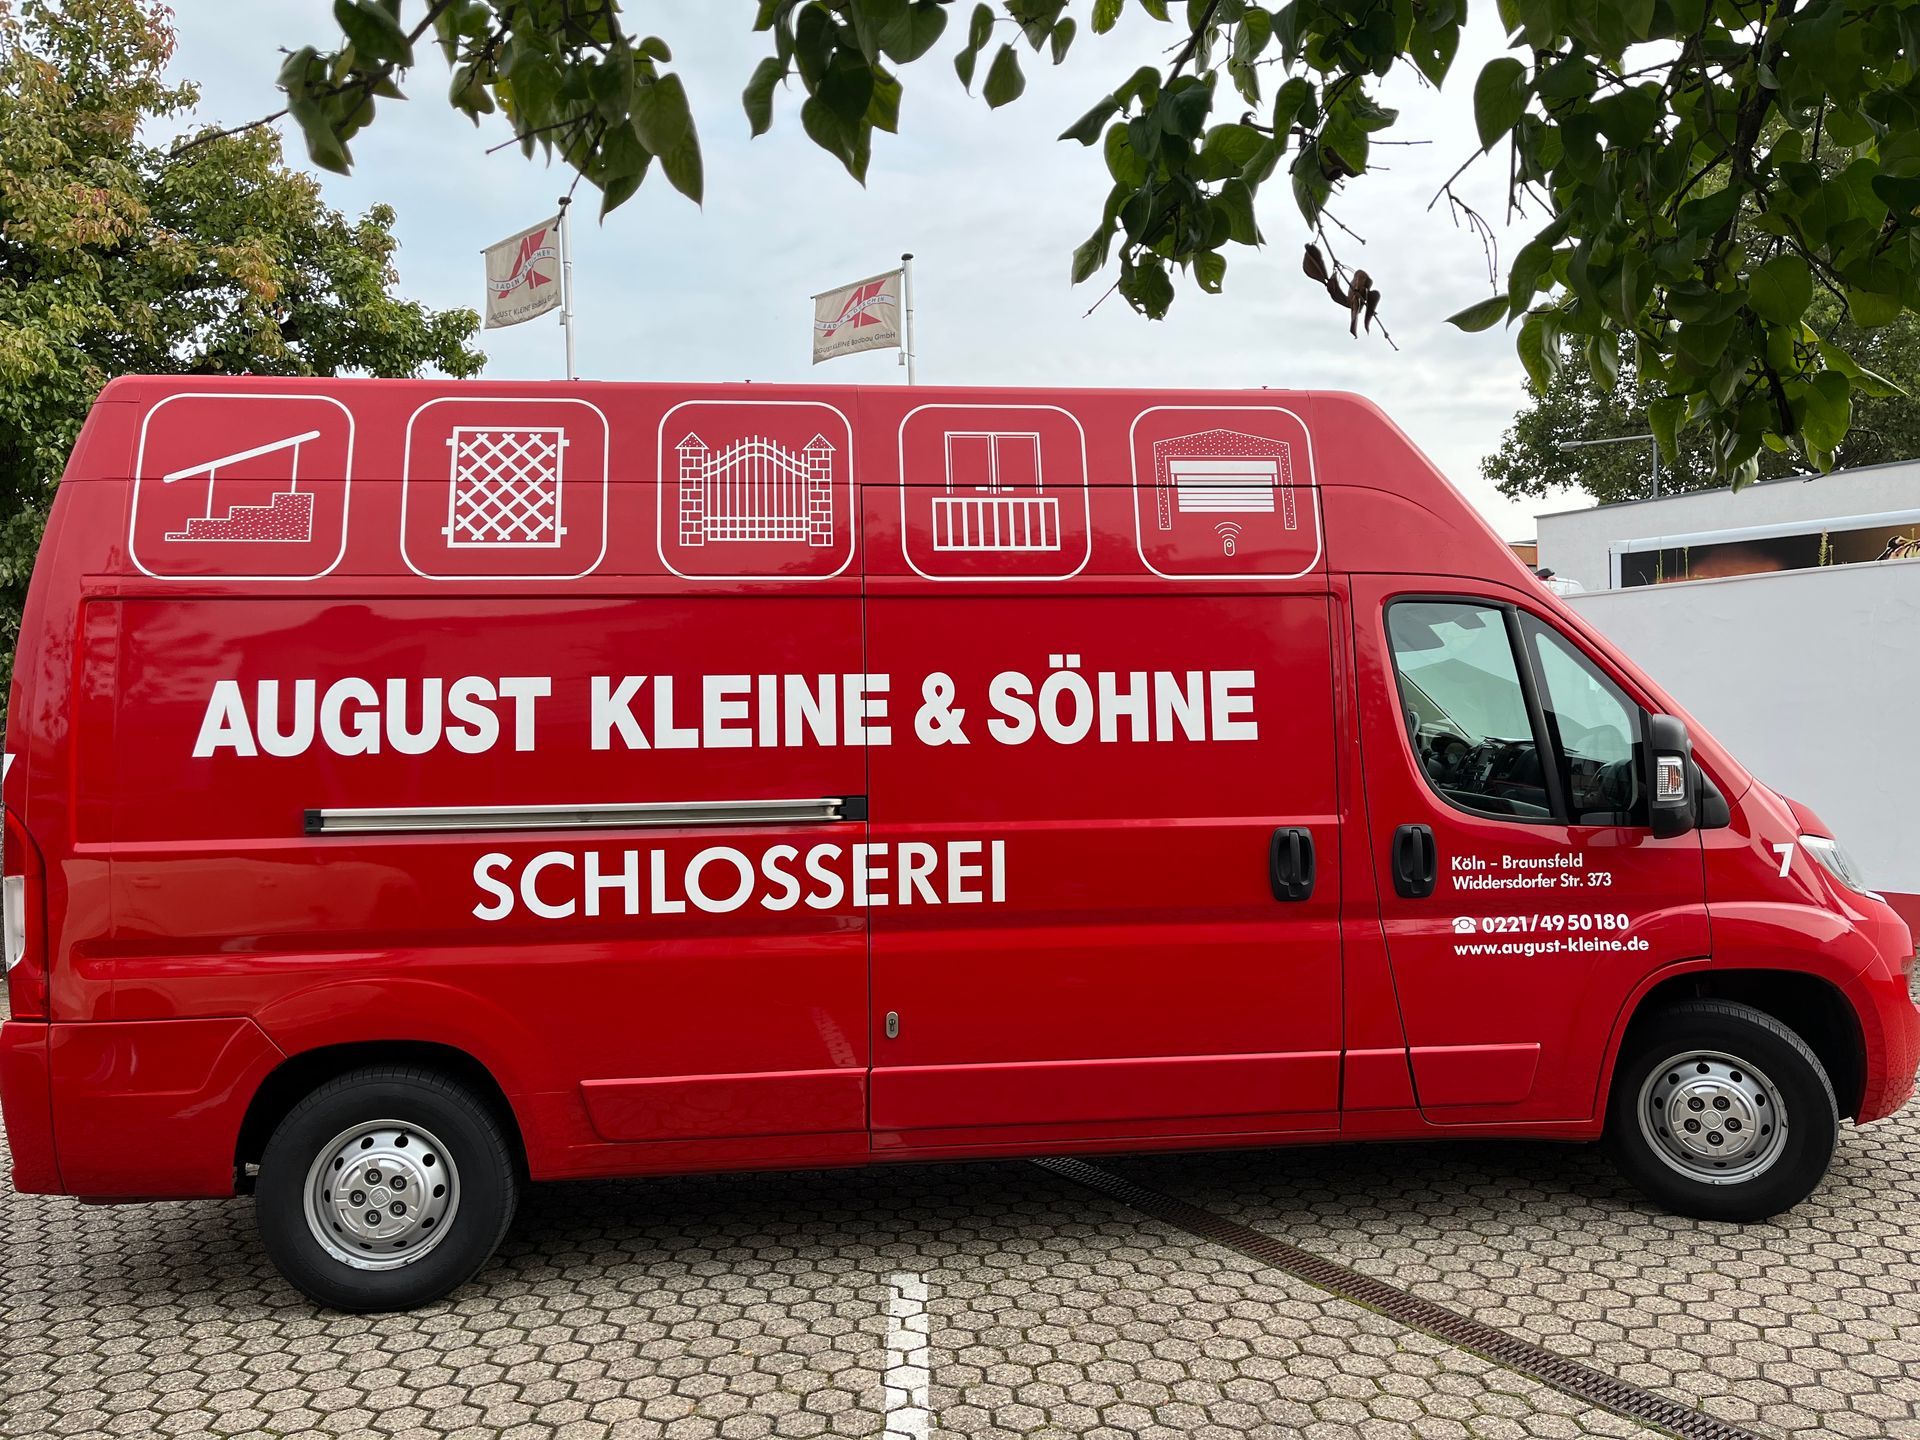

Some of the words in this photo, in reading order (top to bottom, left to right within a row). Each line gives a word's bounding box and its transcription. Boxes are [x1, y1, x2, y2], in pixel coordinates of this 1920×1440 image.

[874, 331, 896, 341] GmbH
[192, 676, 551, 757] AUGUST
[591, 673, 892, 749] KLEINE
[914, 671, 971, 746] &
[987, 654, 1258, 745] SÖHNE
[1451, 855, 1486, 870] Köln
[1502, 852, 1583, 869] Braunsfeld
[1772, 842, 1795, 878] 7
[472, 840, 1005, 921] SCHLOSSEREI
[1452, 873, 1557, 890] Widdersdorfer
[1560, 872, 1584, 887] Str.
[1587, 872, 1612, 887] 373
[1453, 935, 1650, 957] www.august-kleine.de
